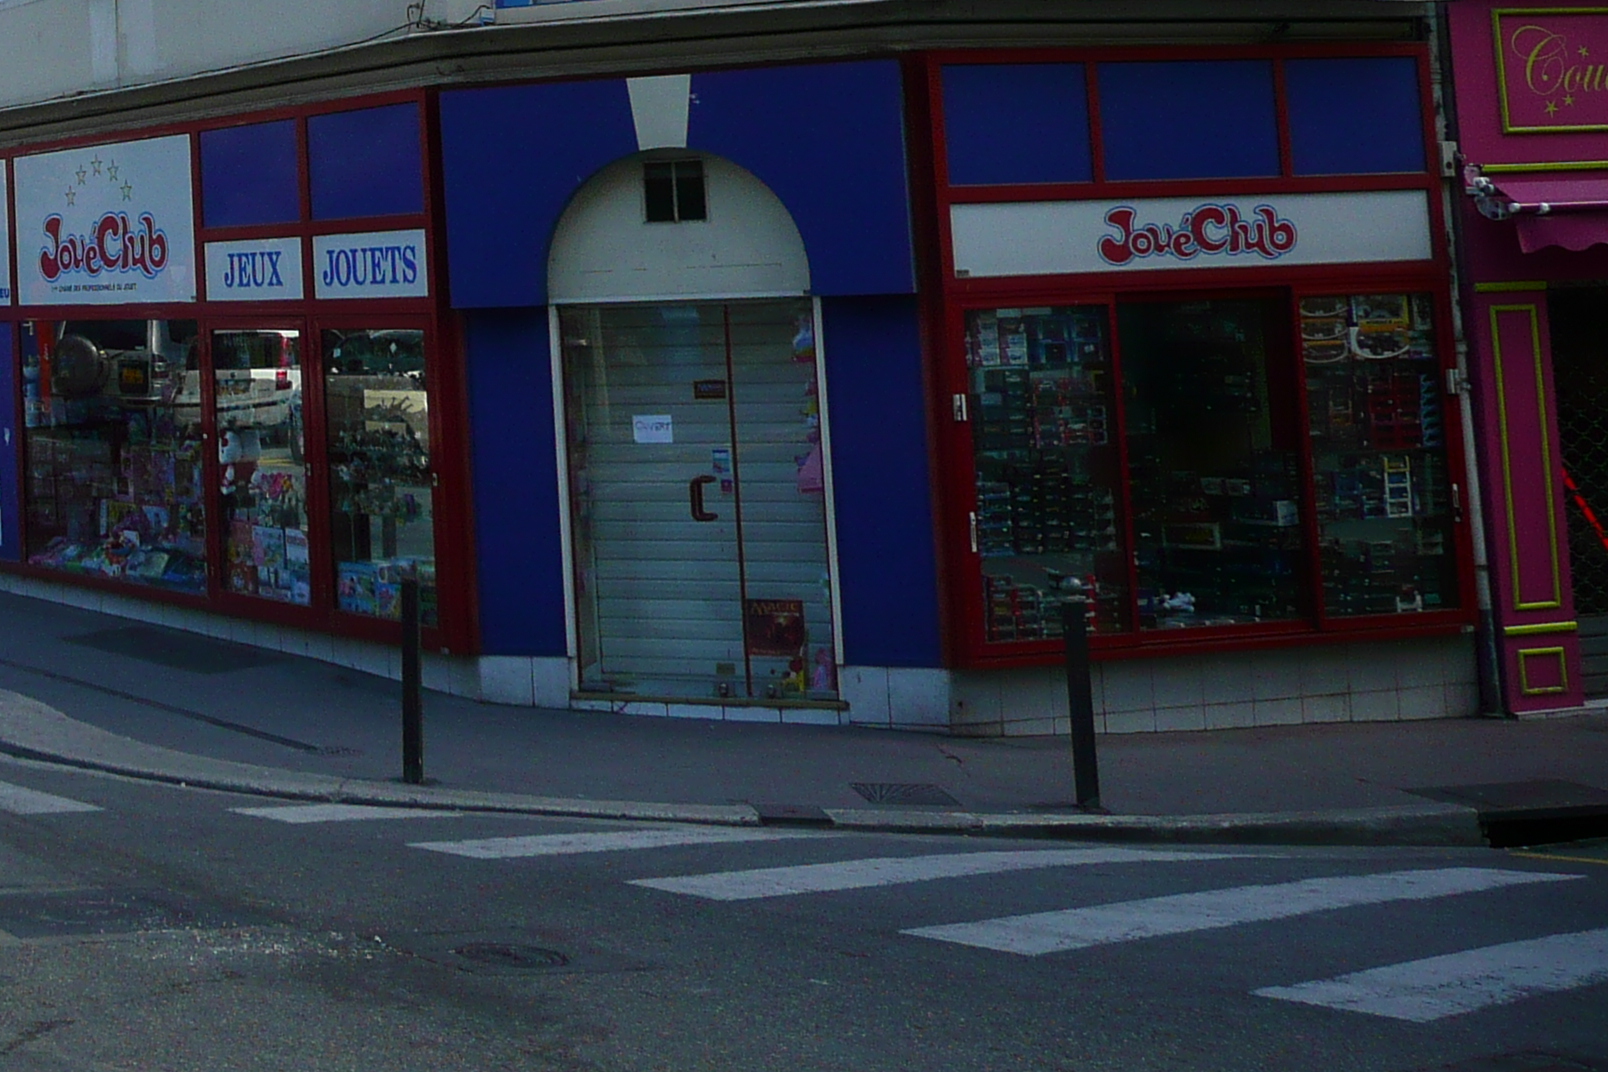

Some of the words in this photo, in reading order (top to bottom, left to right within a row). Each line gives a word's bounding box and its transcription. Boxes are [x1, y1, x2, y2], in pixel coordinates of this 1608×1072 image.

[39, 211, 169, 283] JouéClub
[1097, 202, 1298, 266] JouéClub
[223, 250, 284, 289] JEUX
[322, 245, 418, 288] JOUETS
